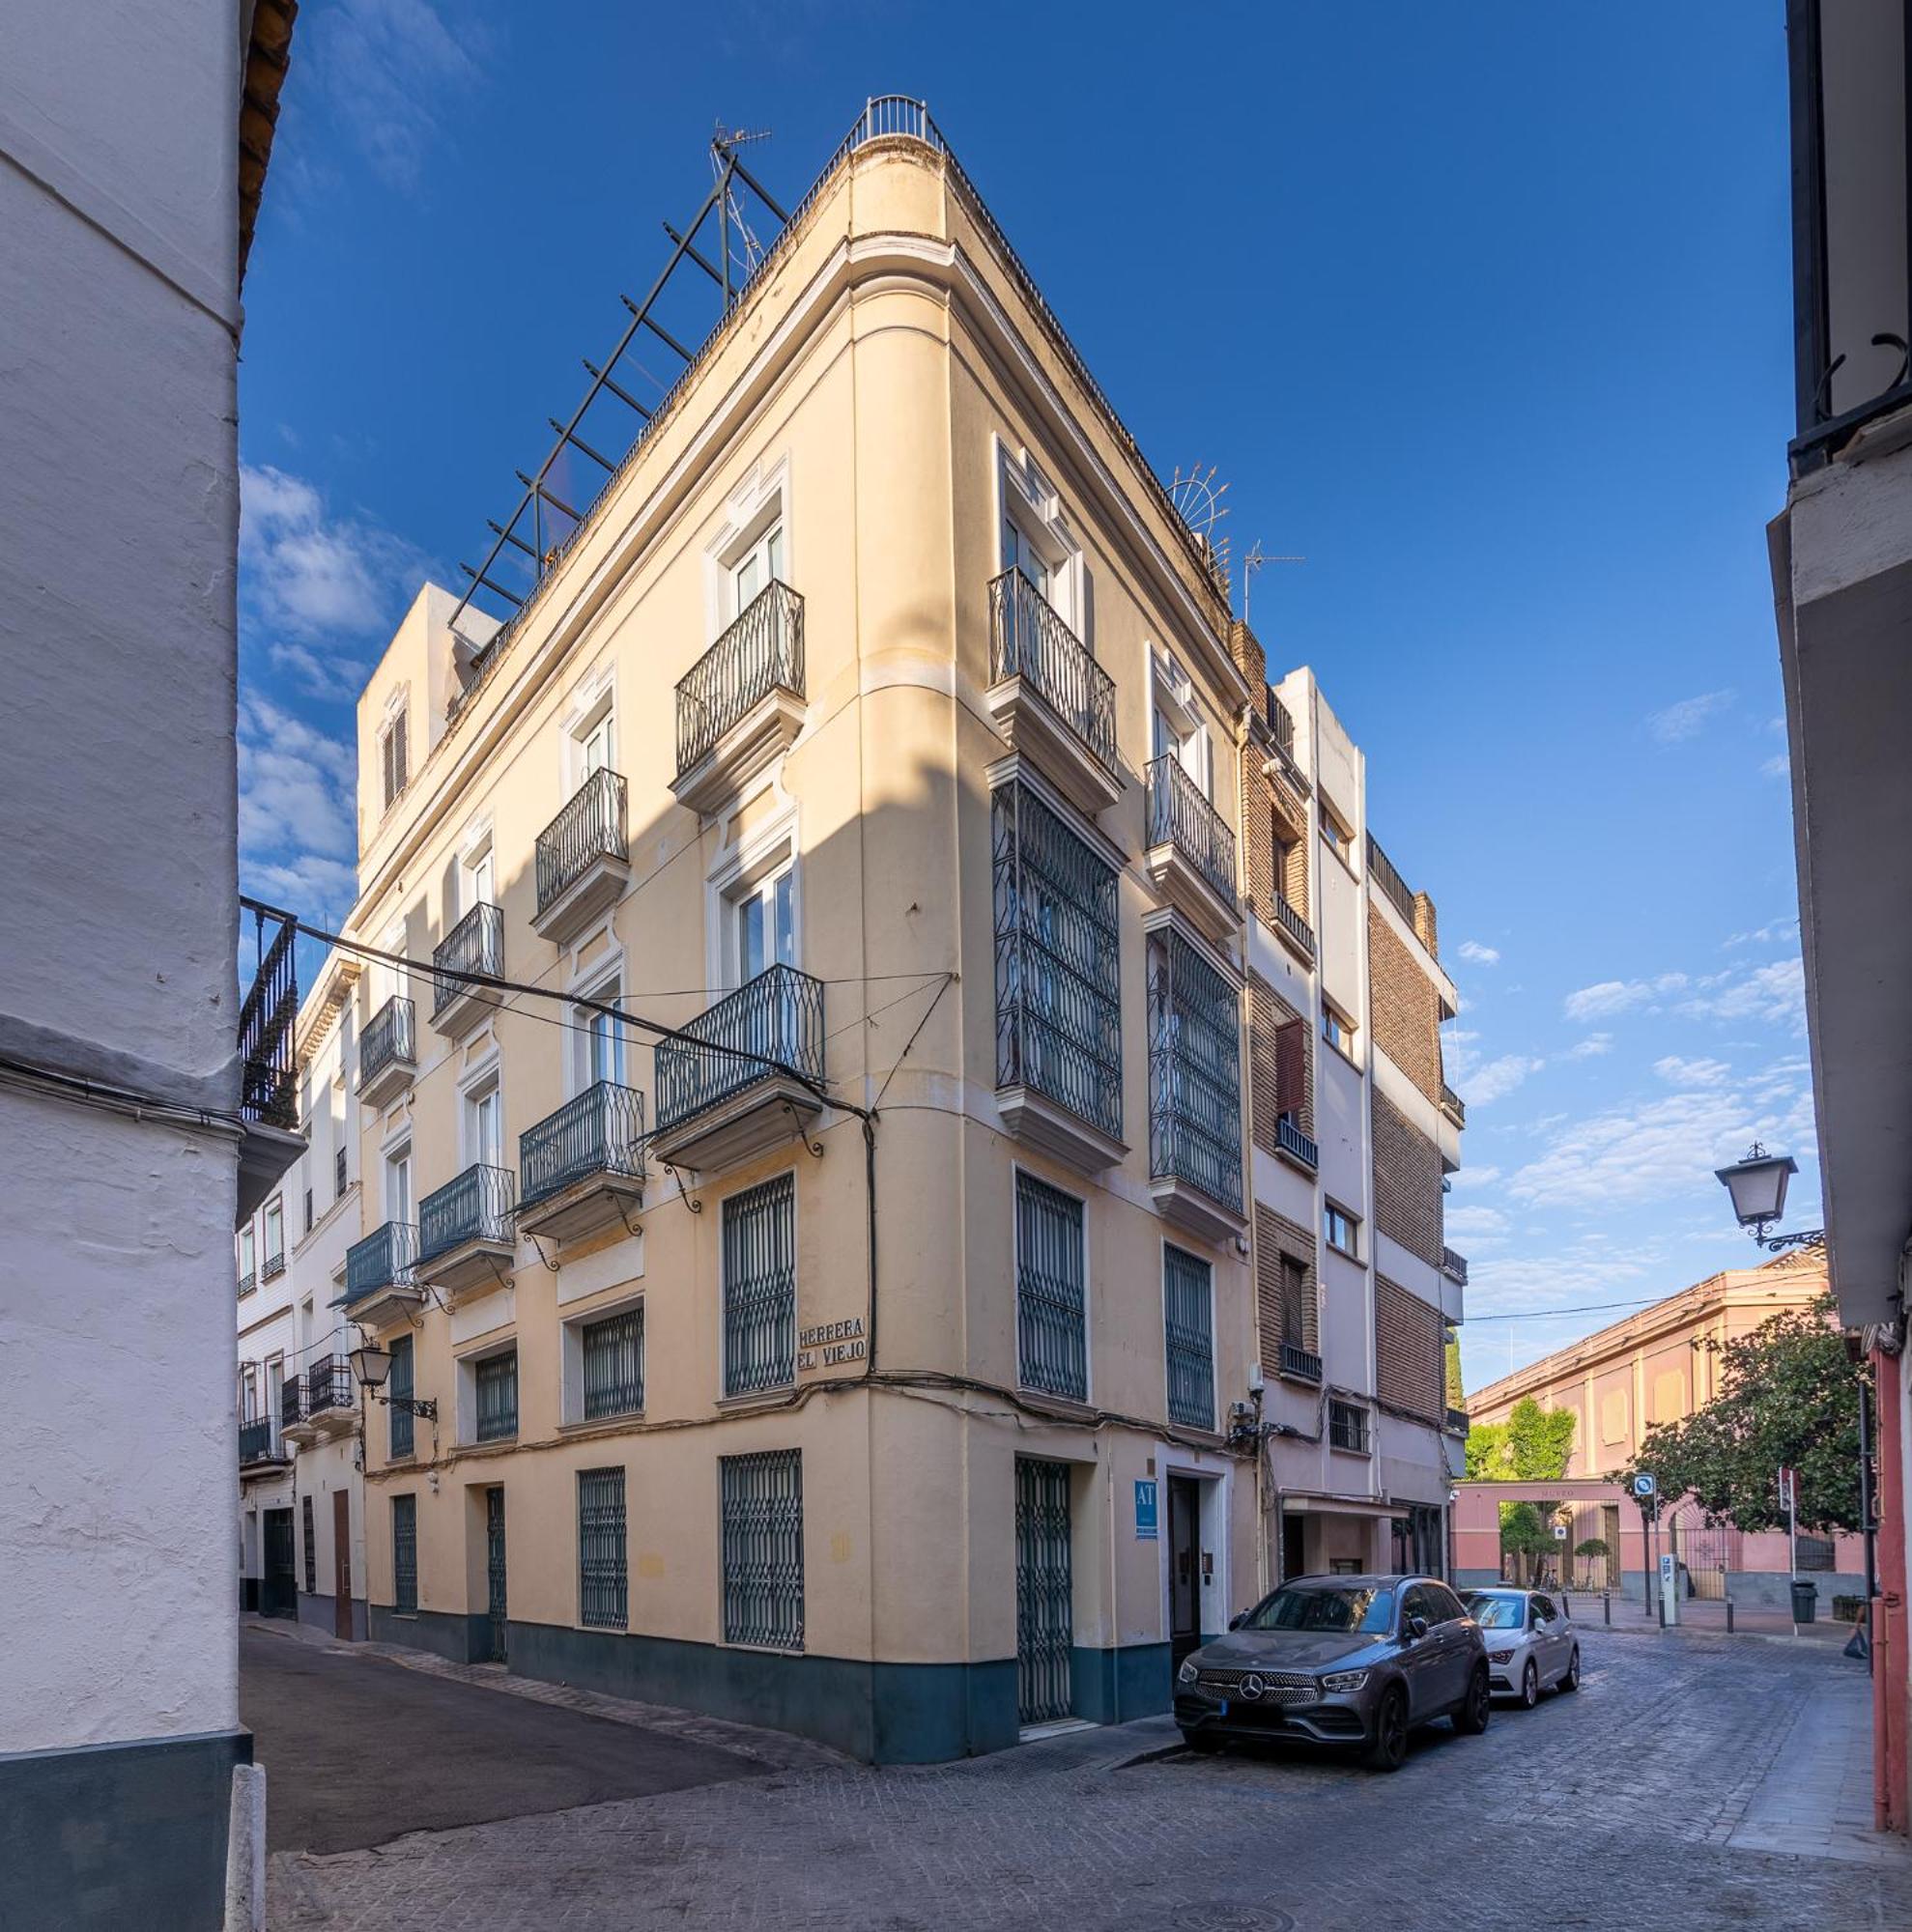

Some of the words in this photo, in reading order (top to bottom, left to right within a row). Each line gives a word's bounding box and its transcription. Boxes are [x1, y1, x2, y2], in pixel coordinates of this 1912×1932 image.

[799, 1319, 863, 1346] HERRERA
[798, 1352, 814, 1368] EL
[823, 1341, 865, 1363] VIEJO
[1137, 1485, 1154, 1505] AT
